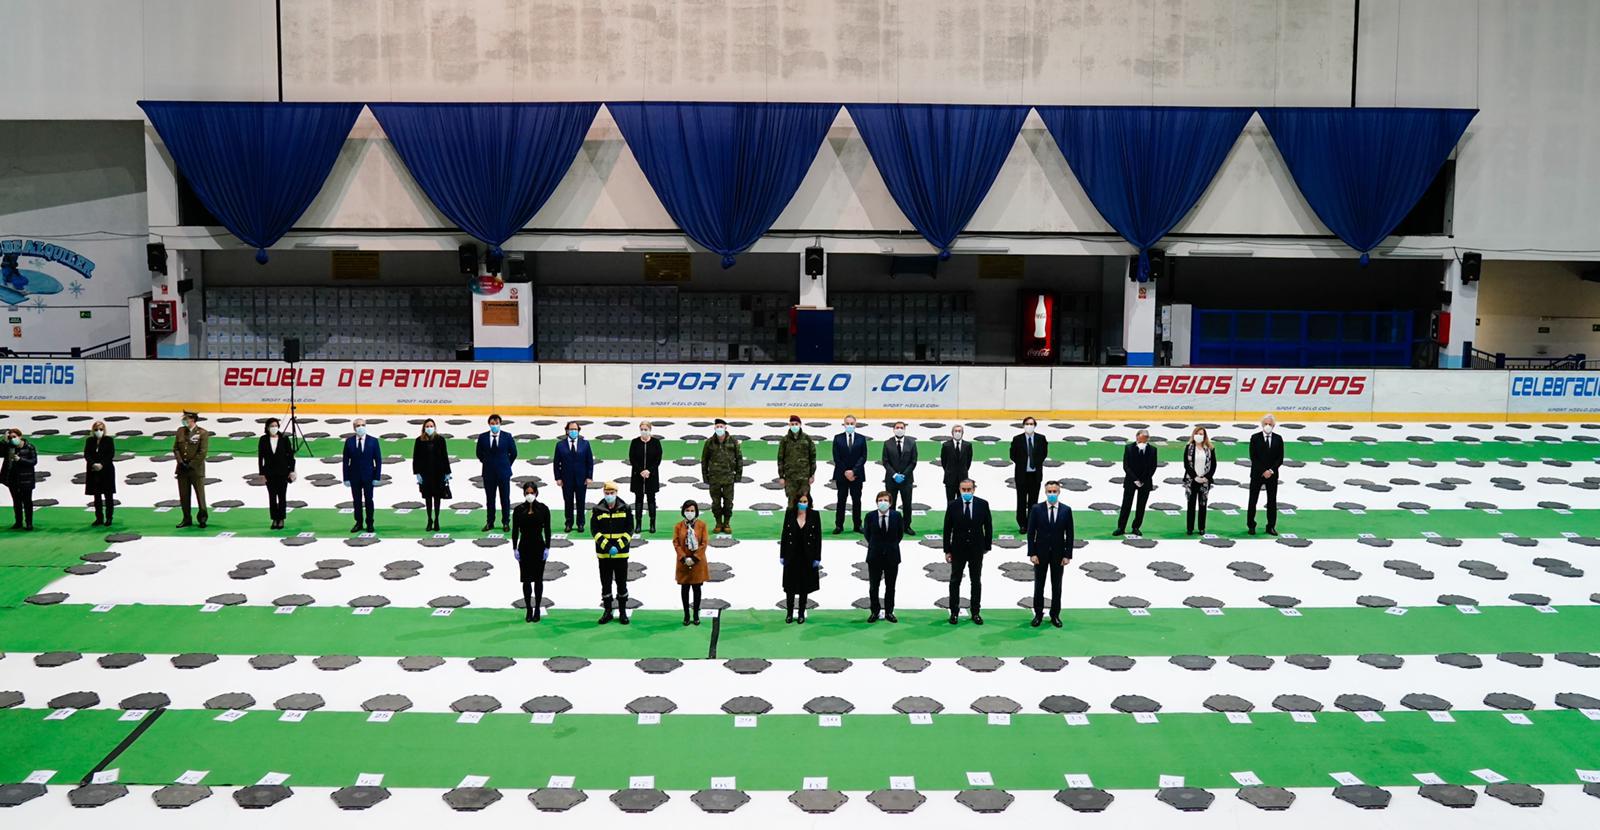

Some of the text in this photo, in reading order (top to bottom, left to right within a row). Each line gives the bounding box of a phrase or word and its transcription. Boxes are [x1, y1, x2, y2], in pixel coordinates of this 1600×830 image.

[379, 368, 490, 390] PATINAJE
[638, 372, 950, 394] SPORT HIELO .COM
[1102, 374, 1232, 394] COLEGIOS
[1262, 376, 1366, 396] GRUPOS
[1511, 376, 1600, 396] CELEBRACI
